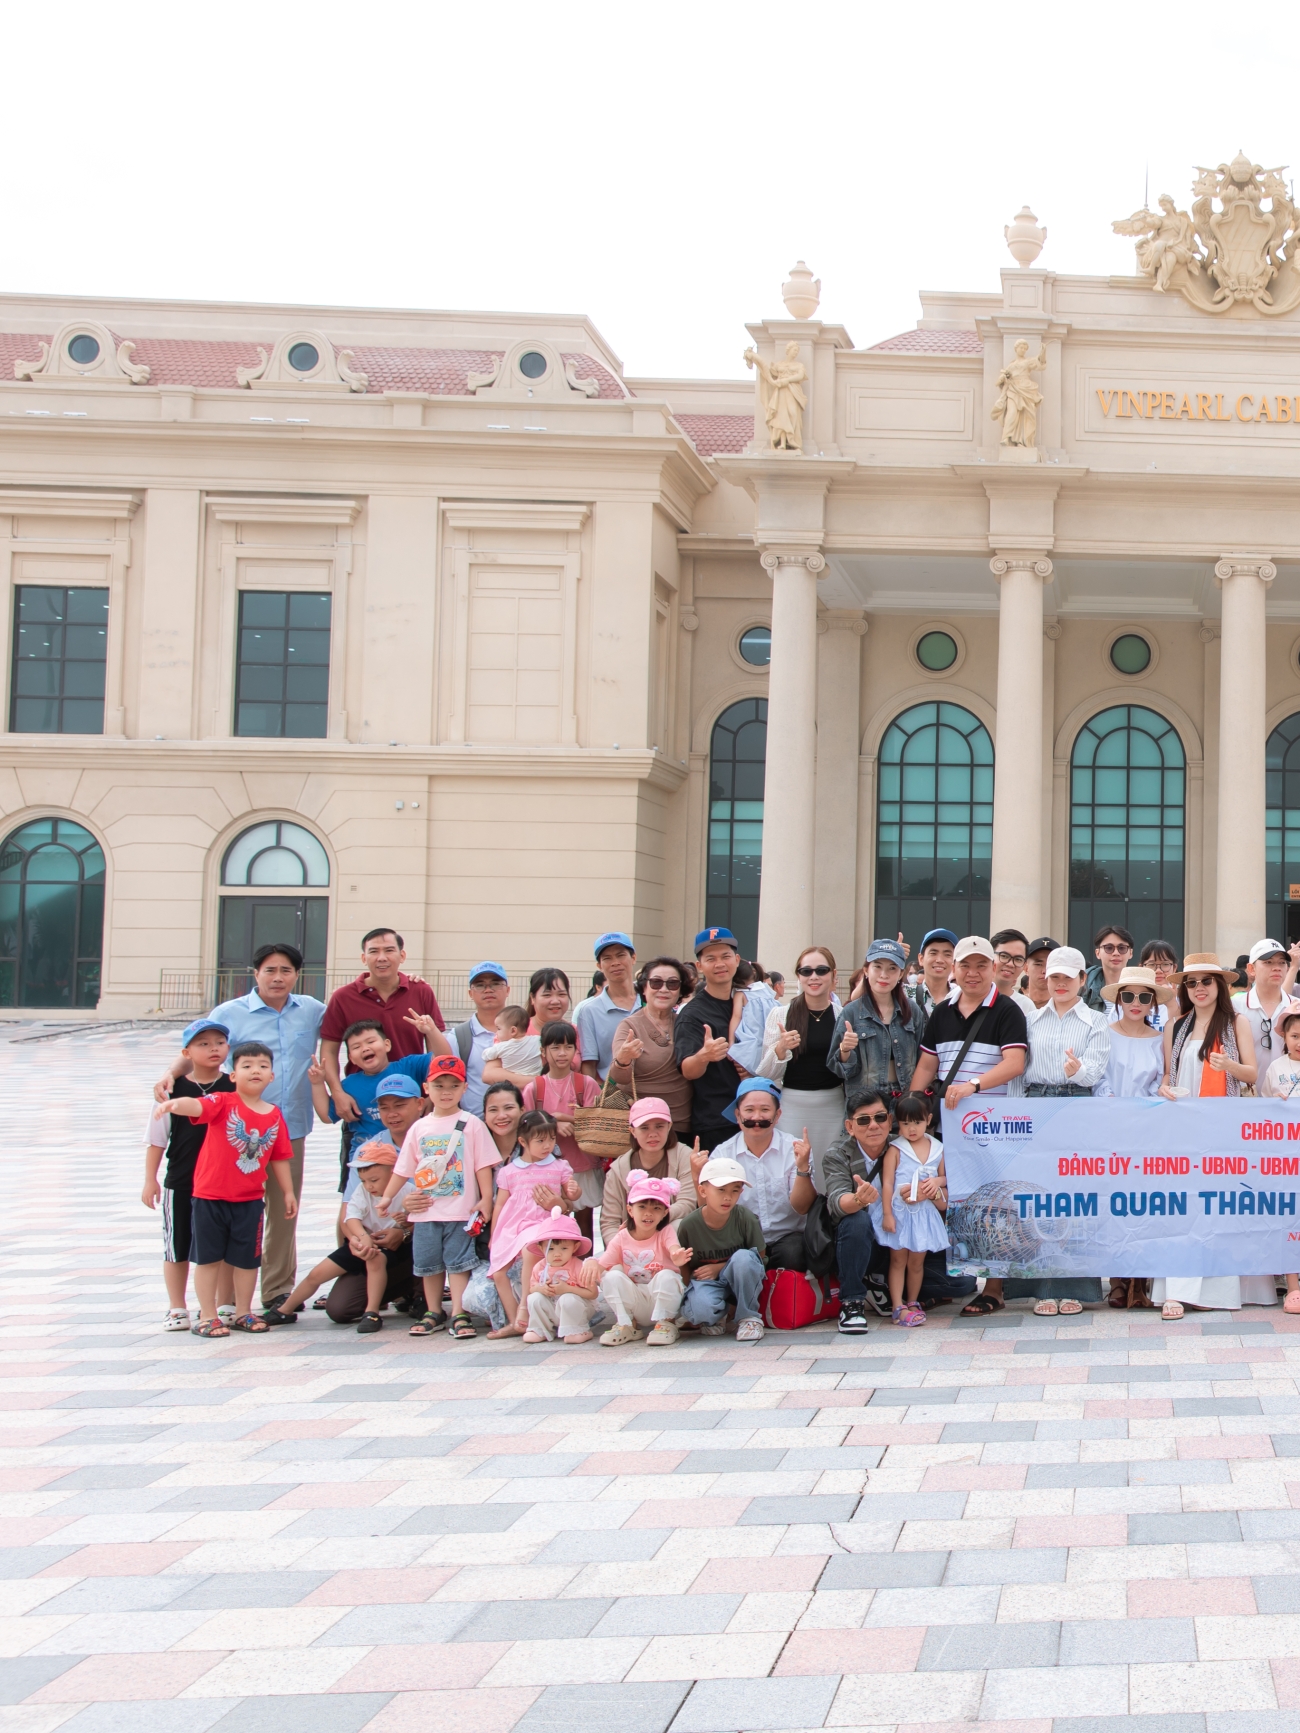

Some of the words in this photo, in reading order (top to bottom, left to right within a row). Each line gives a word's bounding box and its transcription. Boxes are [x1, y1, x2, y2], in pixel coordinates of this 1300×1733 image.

[1096, 389, 1232, 421] VINPEARL
[709, 929, 719, 940] F
[972, 1122, 1002, 1134] NEW
[1004, 1121, 1033, 1134] TIME
[1241, 1119, 1284, 1140] CHÀO
[1058, 1152, 1106, 1176] ĐẢNG
[1108, 1152, 1132, 1176] ỦY
[1143, 1156, 1190, 1175] HĐND
[1202, 1156, 1248, 1175] UBND
[1013, 1193, 1098, 1218] THAM
[1110, 1192, 1187, 1218] QUAN
[1198, 1182, 1296, 1216] THÀNH
